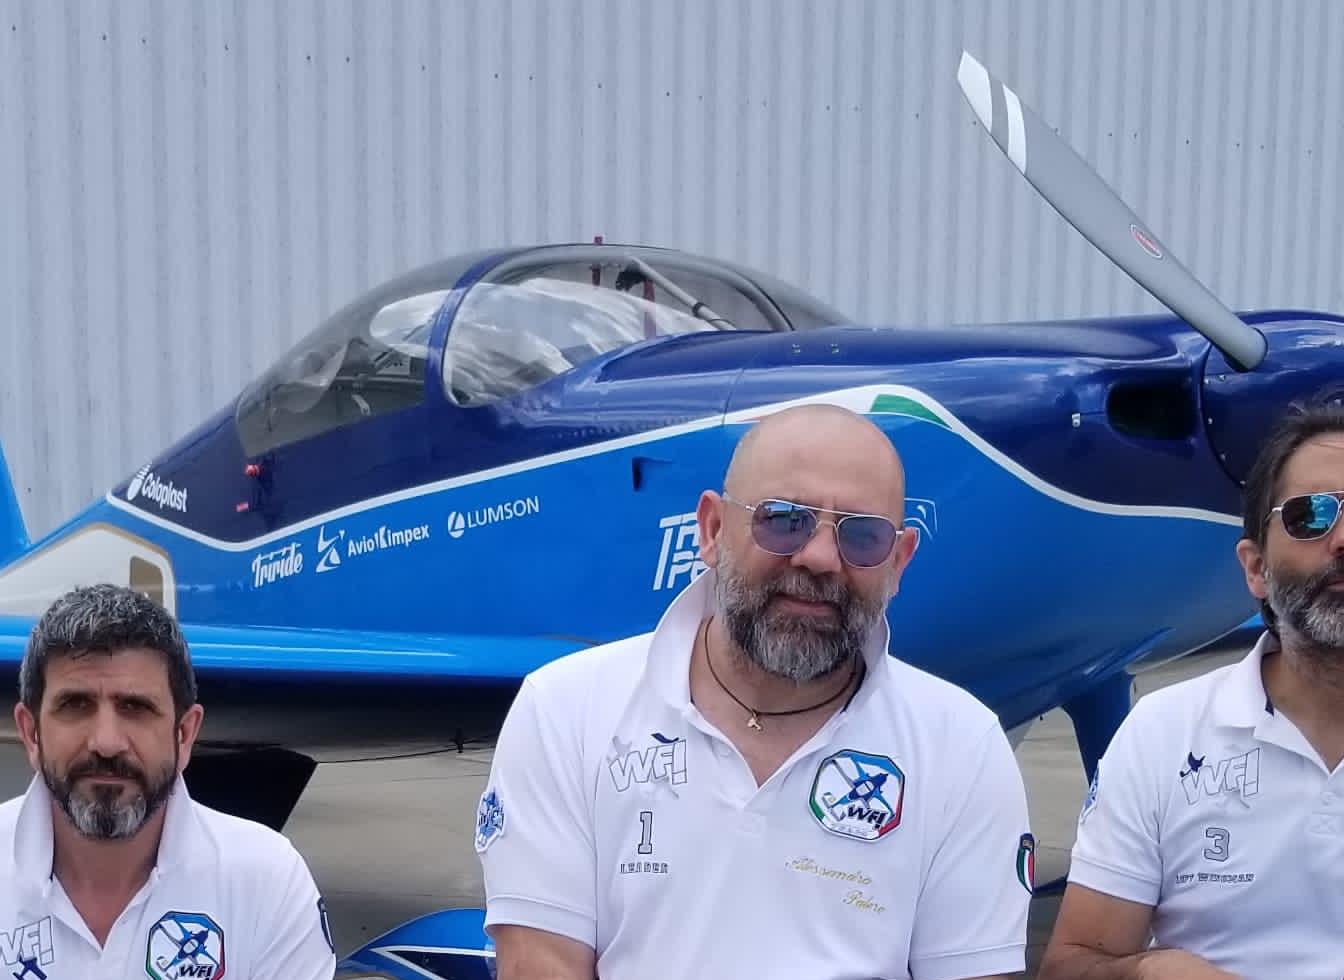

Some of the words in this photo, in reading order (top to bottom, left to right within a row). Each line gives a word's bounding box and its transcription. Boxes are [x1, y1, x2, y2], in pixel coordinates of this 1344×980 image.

[142, 472, 188, 513] Coloplast
[467, 495, 540, 528] LUMSON
[252, 542, 304, 588] Triride
[609, 739, 687, 793] WF!
[1181, 747, 1260, 806] WF!
[637, 811, 653, 854] 1
[848, 804, 888, 829] WF!
[1203, 827, 1230, 862] 3
[620, 861, 668, 874] LEADER
